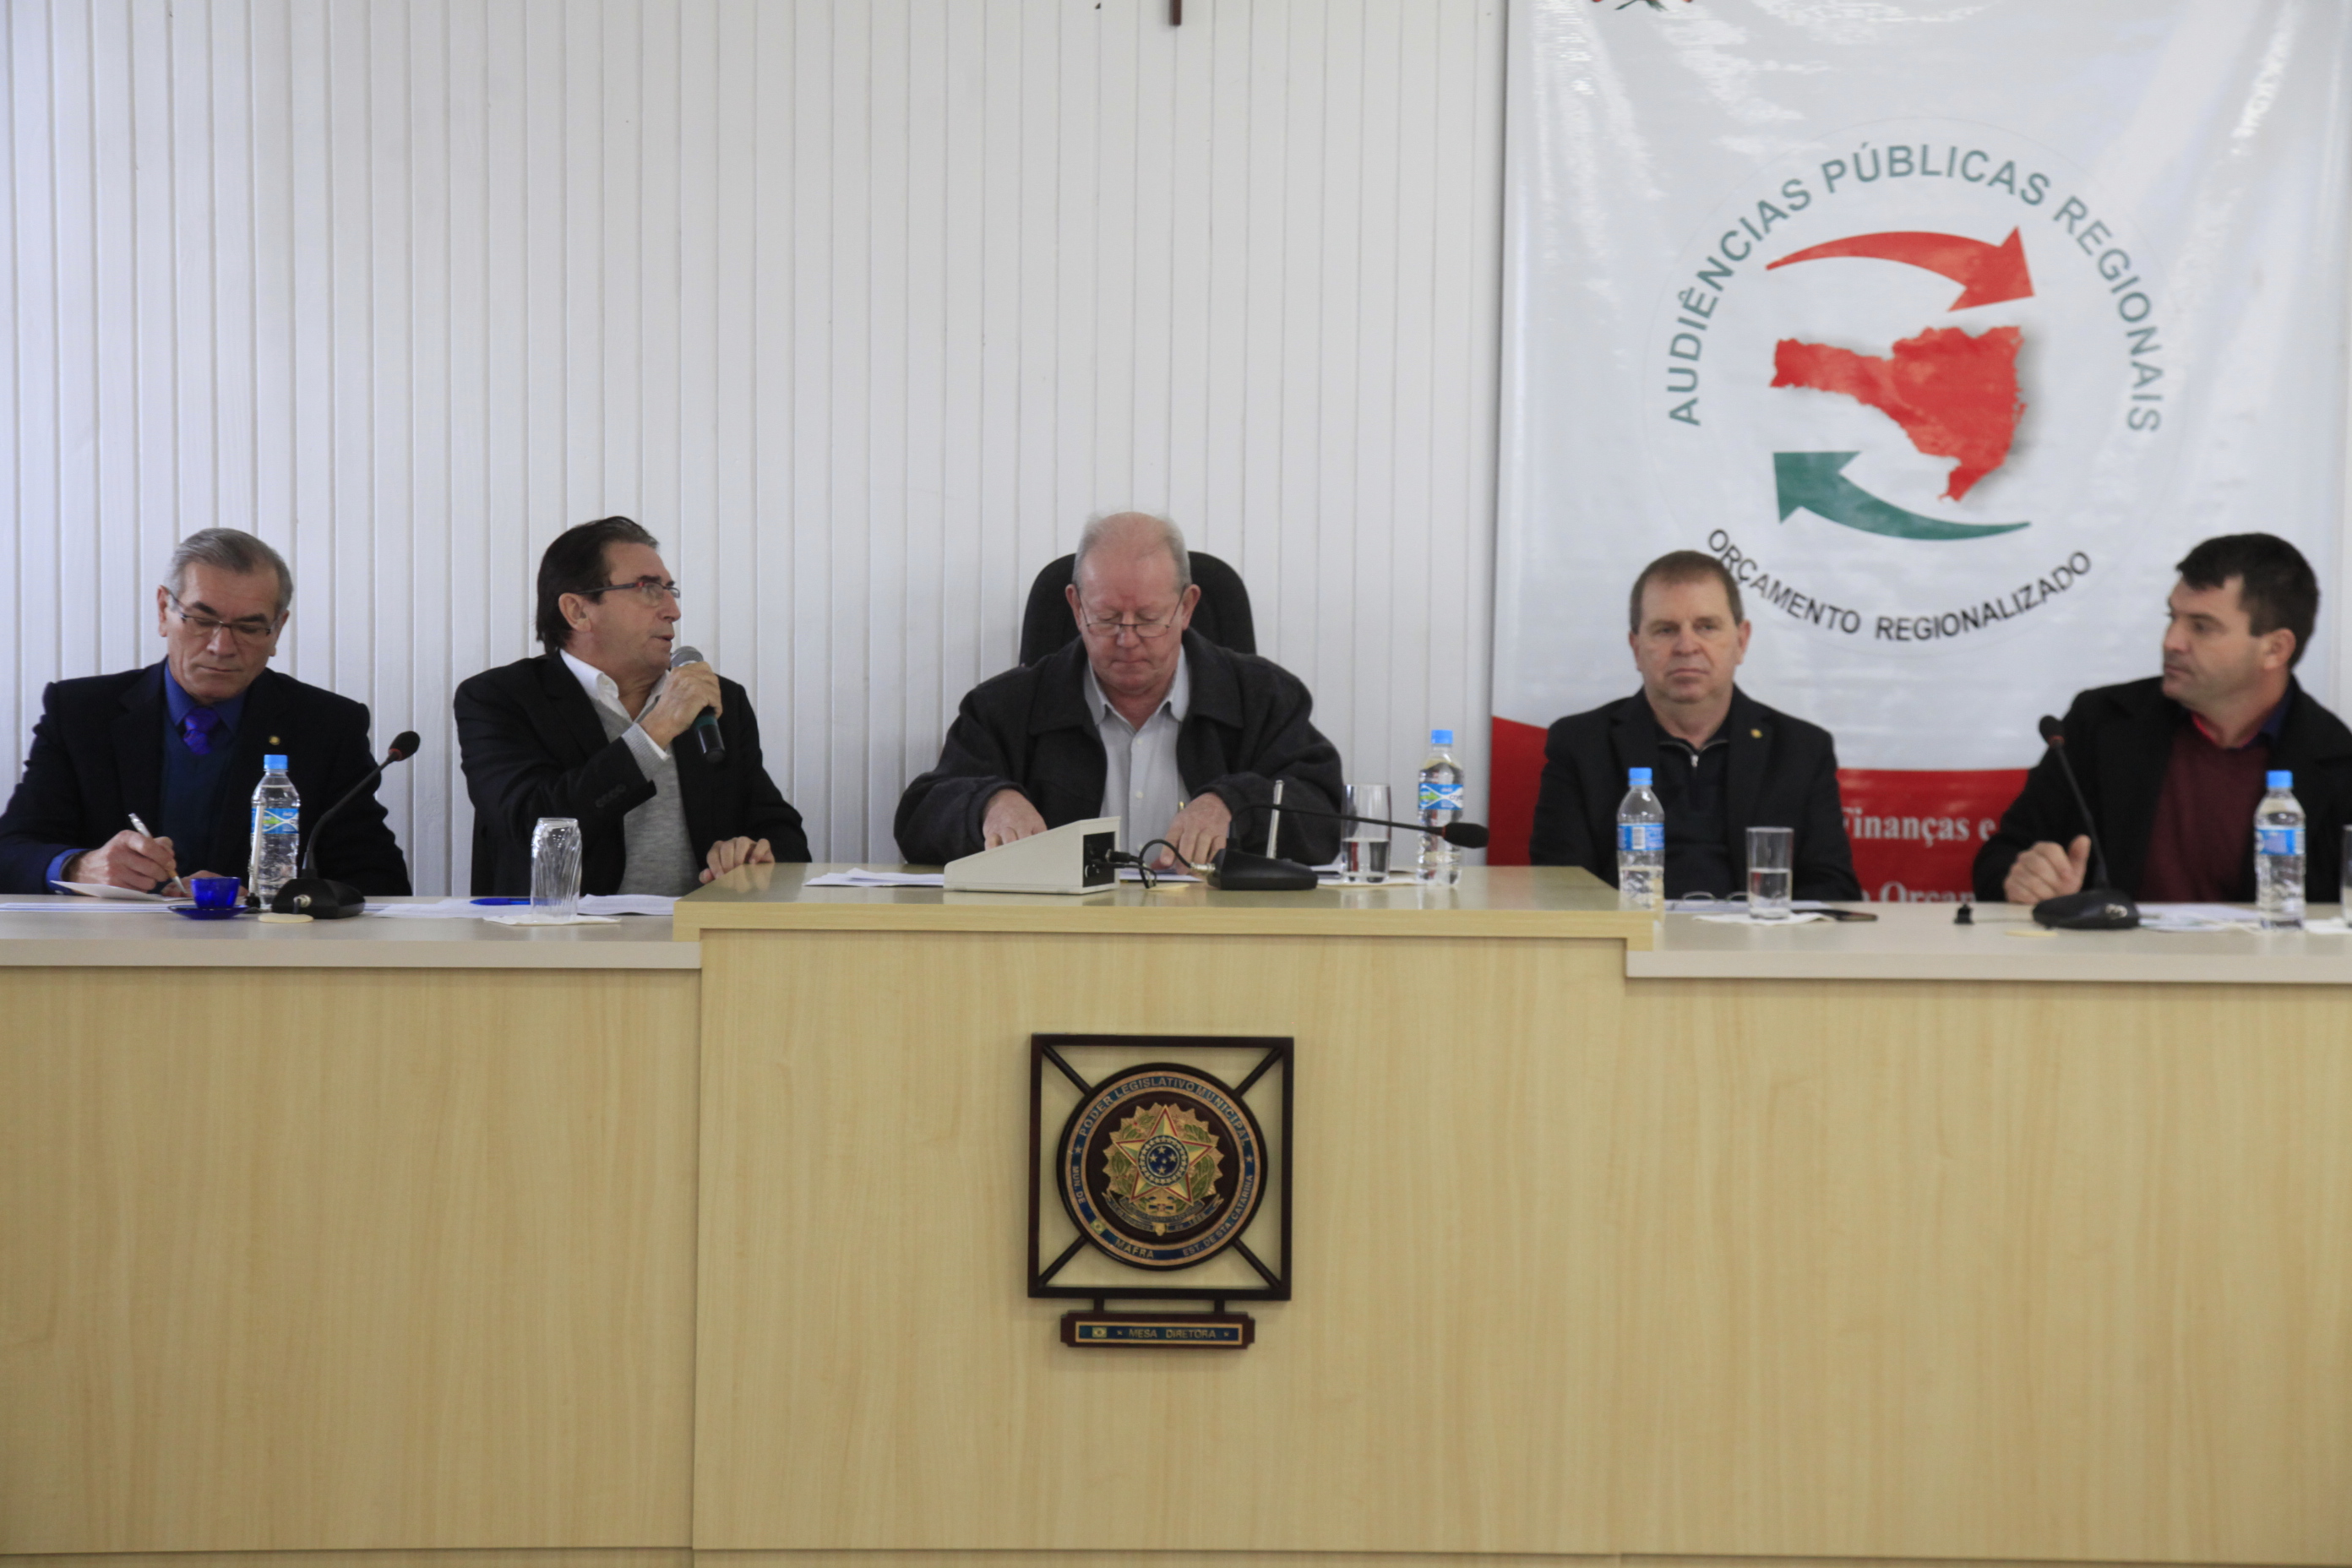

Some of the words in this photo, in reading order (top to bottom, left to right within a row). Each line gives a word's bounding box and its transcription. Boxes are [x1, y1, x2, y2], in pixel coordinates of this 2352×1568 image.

[1667, 177, 1812, 427] AUDIÊNCIAS
[1821, 140, 2052, 207] PÚBLICAS
[2052, 195, 2165, 434] REGIONAIS
[1707, 528, 1861, 634] ORÇAMENTO
[1875, 549, 2092, 642] REGIONALIZADO
[1078, 1096, 1116, 1138] PODER
[1114, 1076, 1195, 1099] LEGISLATIVO
[1195, 1086, 1250, 1146] MUNICIPAL
[1076, 1190, 1086, 1205] DE
[1182, 1244, 1204, 1257] EST.
[1203, 1235, 1217, 1248] DE
[1232, 1174, 1254, 1221] CATARINA
[1114, 1234, 1155, 1260] MAFRA
[1129, 1329, 1157, 1338] MESA
[1165, 1329, 1217, 1338] DIRETORA
